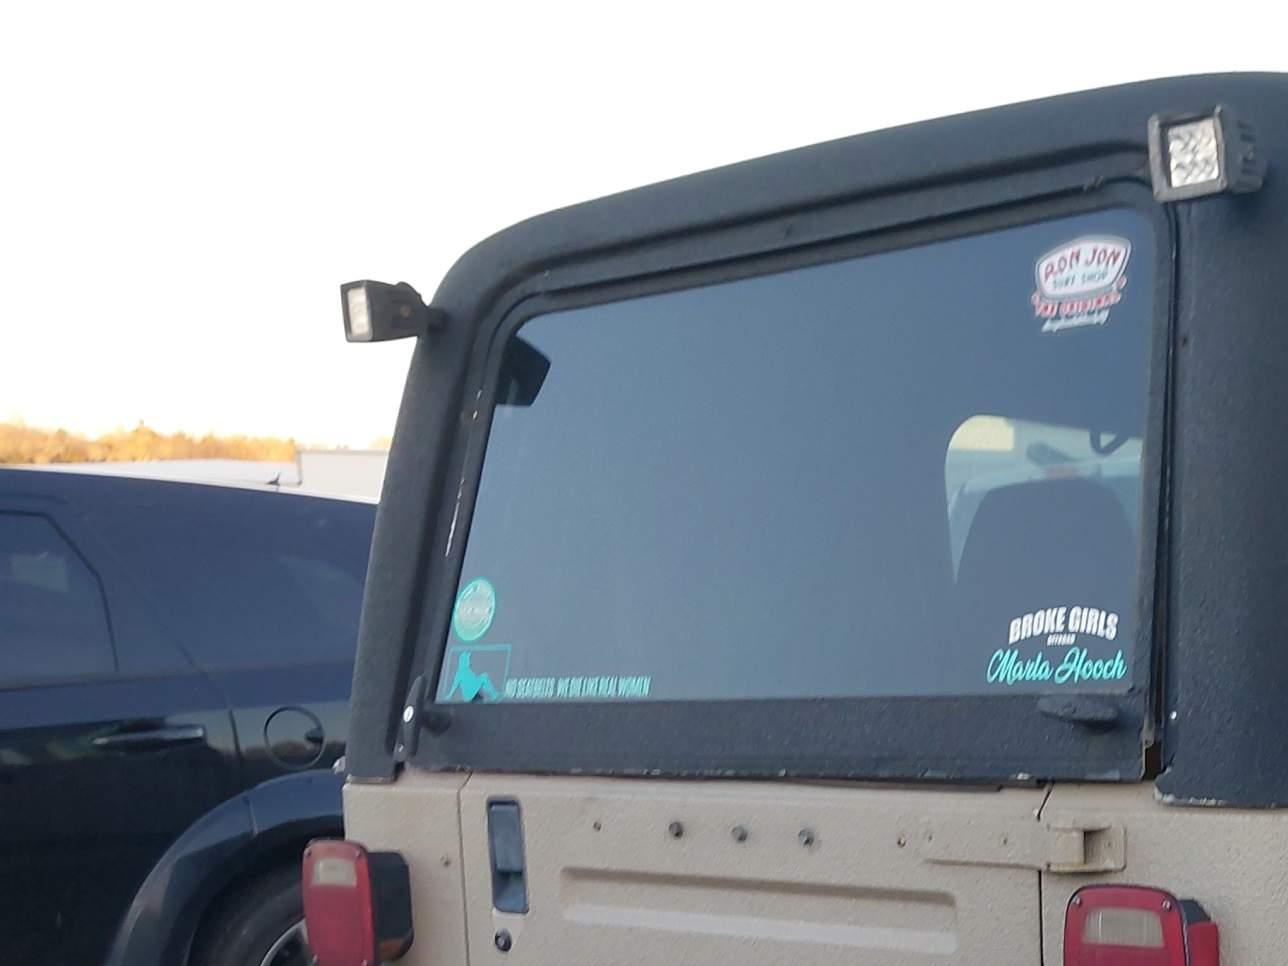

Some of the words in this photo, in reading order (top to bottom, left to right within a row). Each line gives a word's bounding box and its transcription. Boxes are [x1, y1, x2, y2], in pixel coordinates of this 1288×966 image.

[1045, 248, 1081, 280] RON
[1085, 246, 1121, 267] JON
[1008, 605, 1068, 645] BROKE
[1067, 605, 1119, 641] GIRLS
[986, 647, 1053, 686] Marla
[1054, 646, 1128, 685] Hooch
